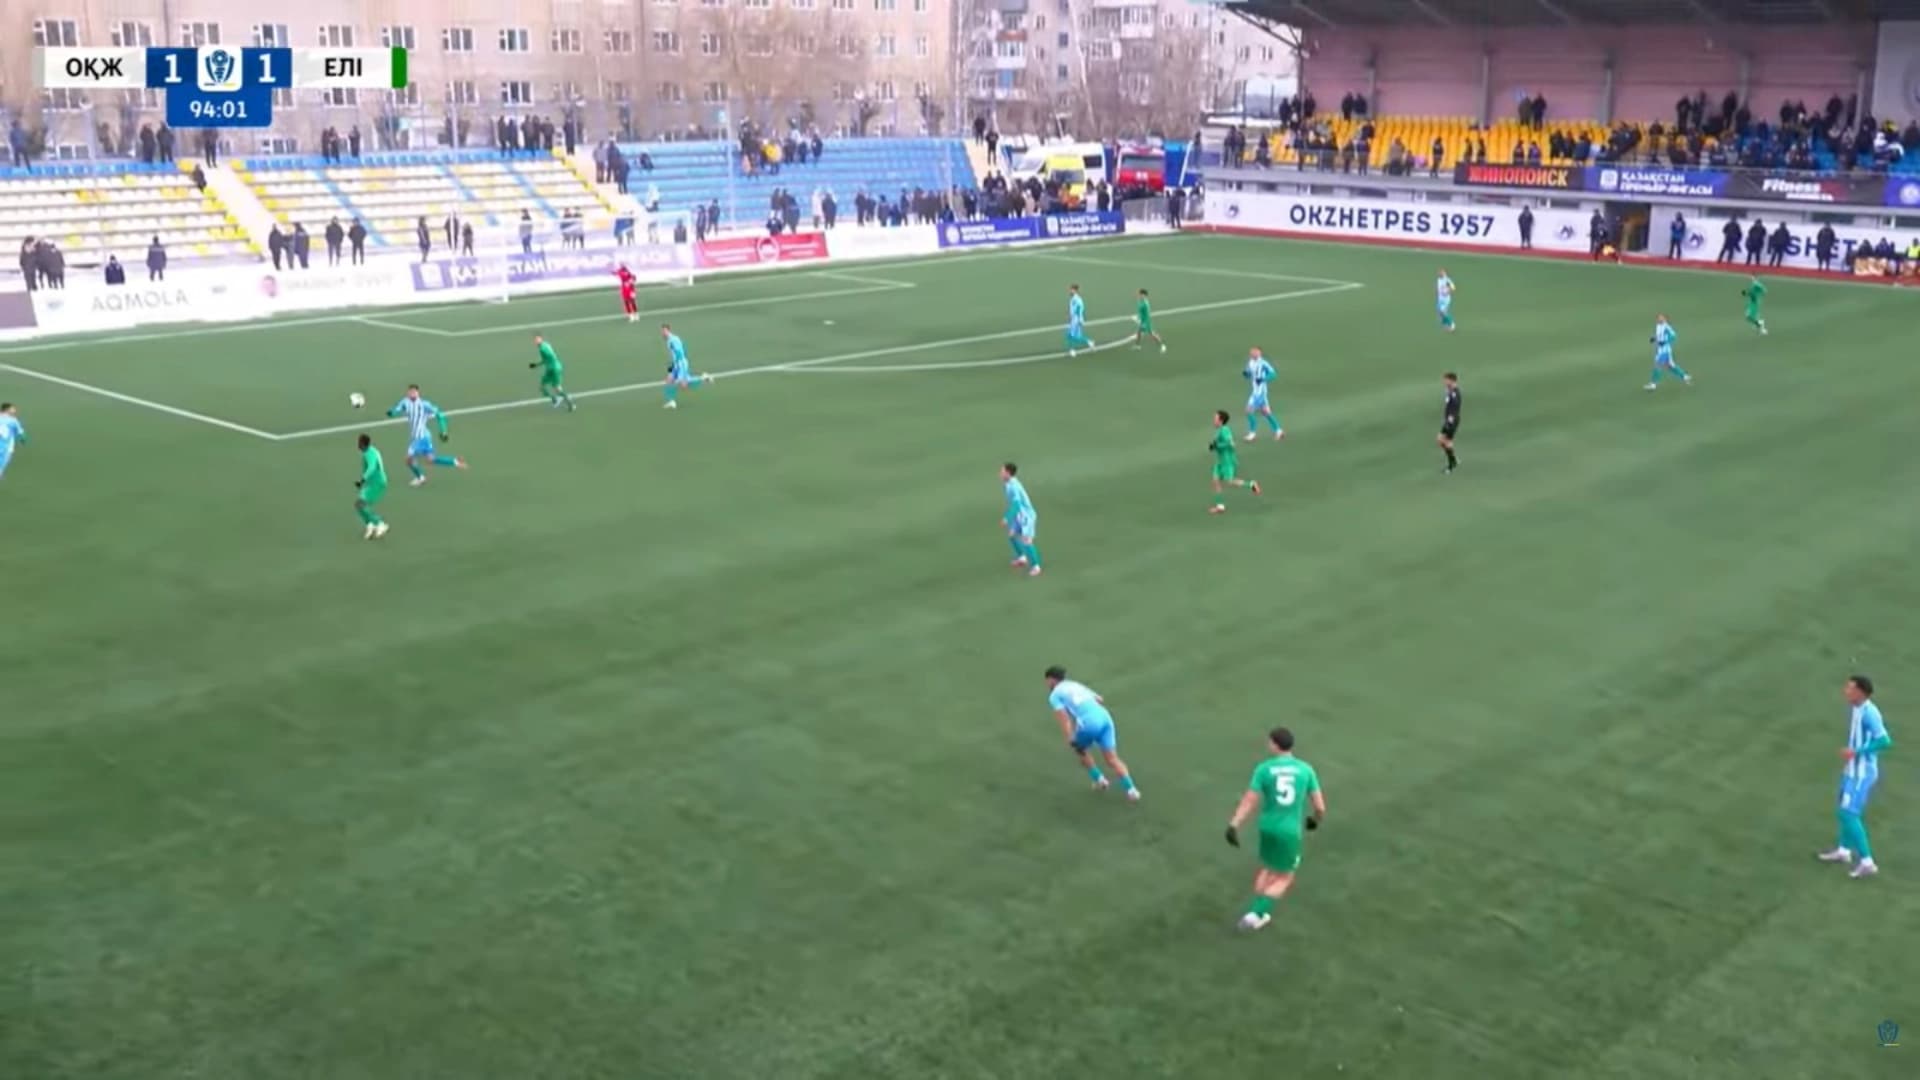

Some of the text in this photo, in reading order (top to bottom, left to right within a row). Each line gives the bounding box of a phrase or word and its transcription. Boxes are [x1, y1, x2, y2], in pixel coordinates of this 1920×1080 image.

[1289, 203, 1495, 237] OKZHETPES 1957
[92, 288, 189, 312] AQMOLA
[1276, 775, 1296, 805] 5
